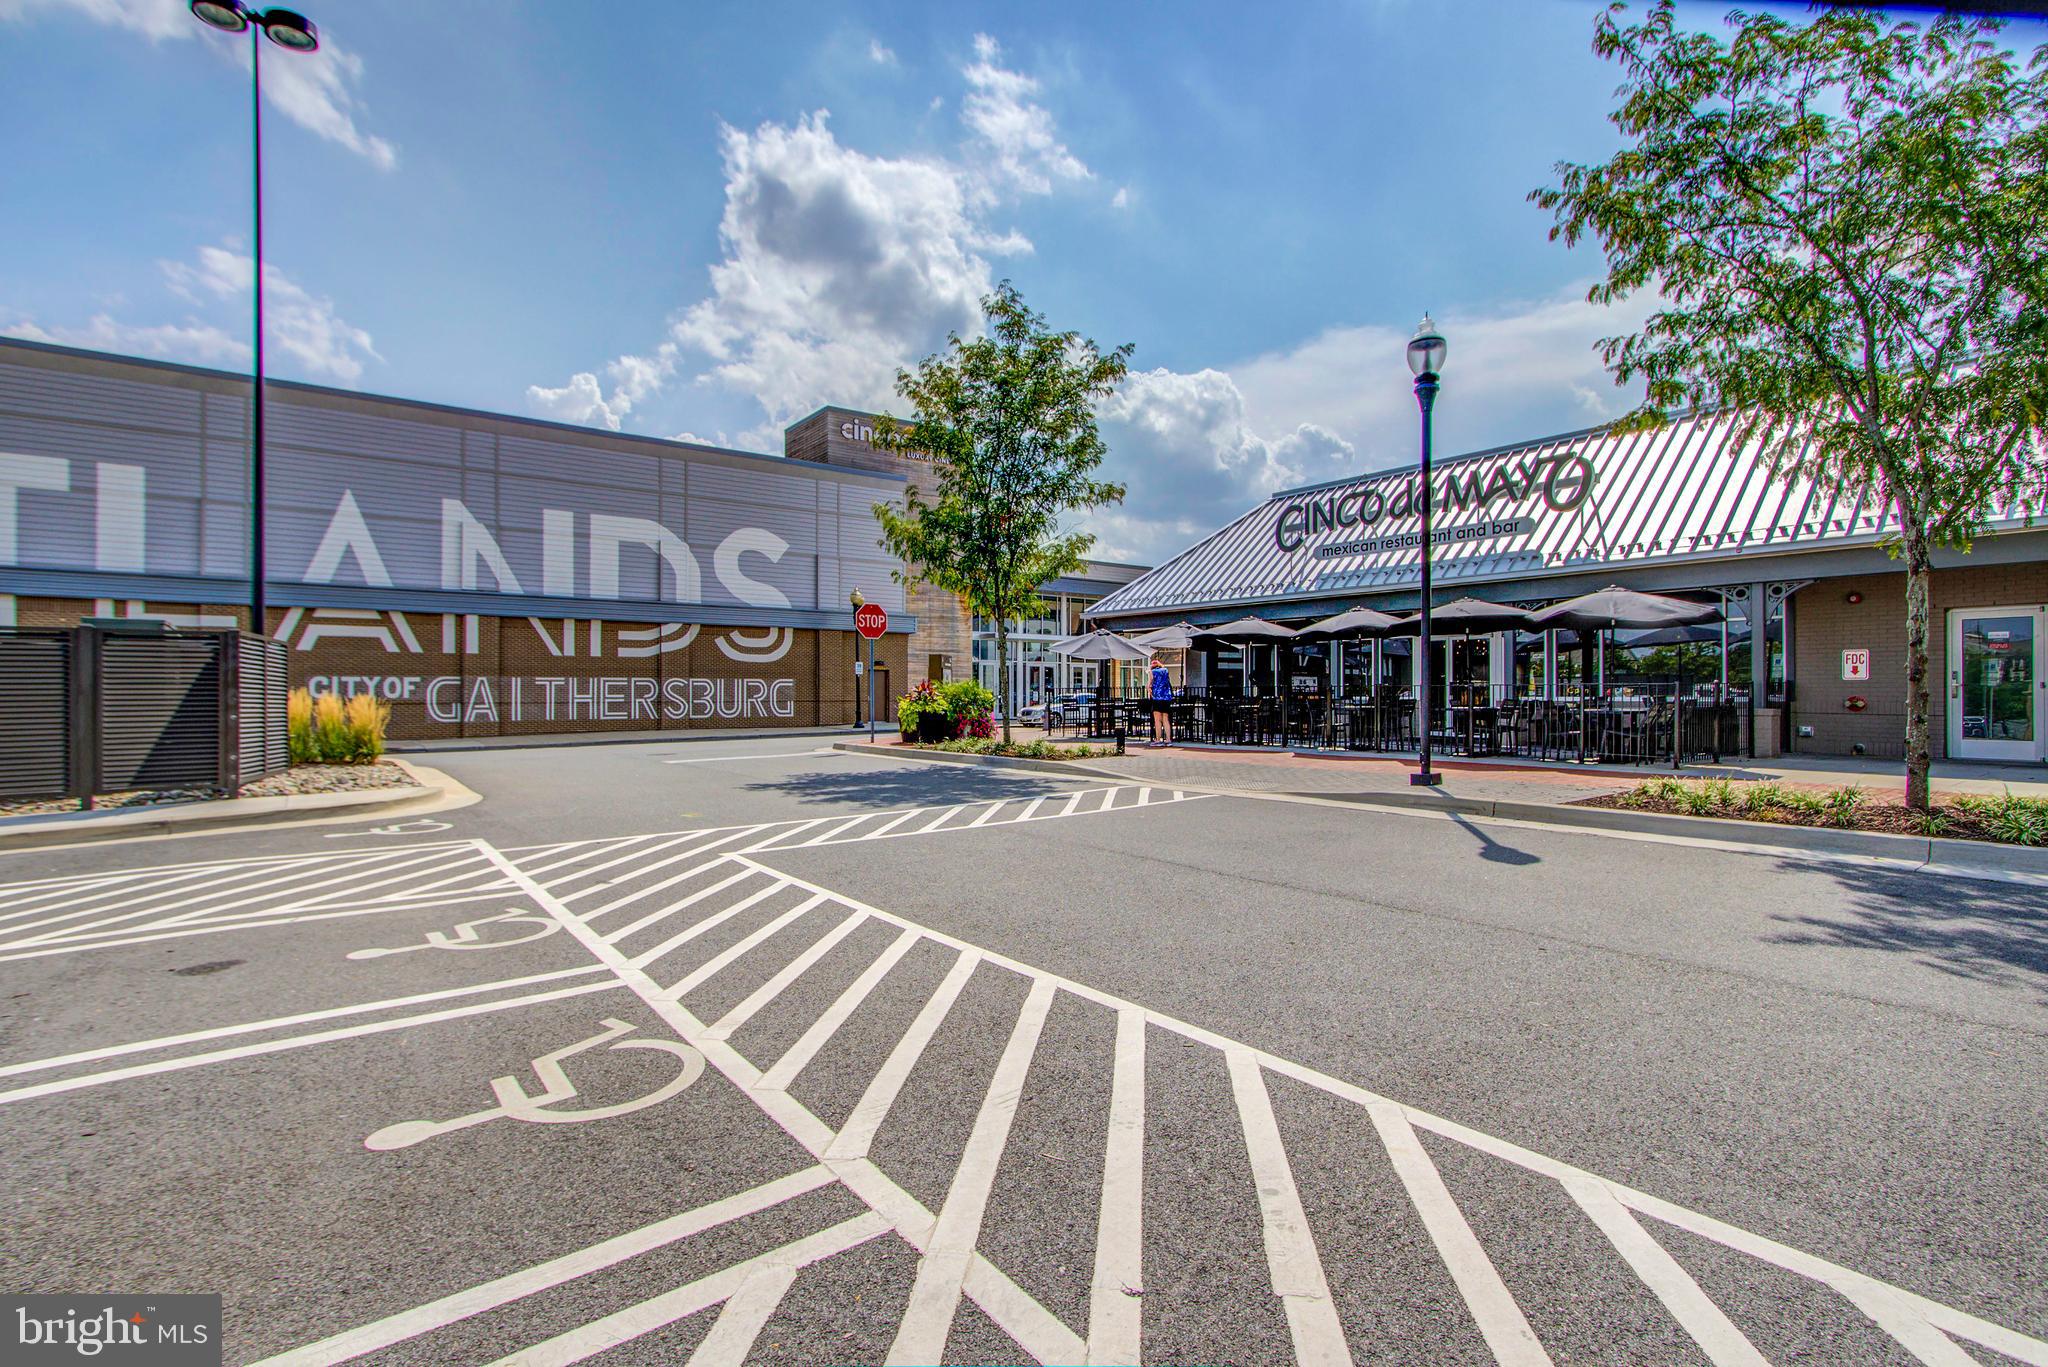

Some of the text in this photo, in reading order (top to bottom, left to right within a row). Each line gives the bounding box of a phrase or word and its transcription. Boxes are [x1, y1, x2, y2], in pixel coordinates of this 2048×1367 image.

[1275, 488, 1386, 553] CINCO
[1442, 451, 1597, 513] MAYO
[1322, 521, 1520, 557] mexican restauant and bar
[858, 614, 885, 628] STOP
[1845, 653, 1865, 665] FDC
[308, 675, 795, 723] CITY OF GAITHERSBURG
